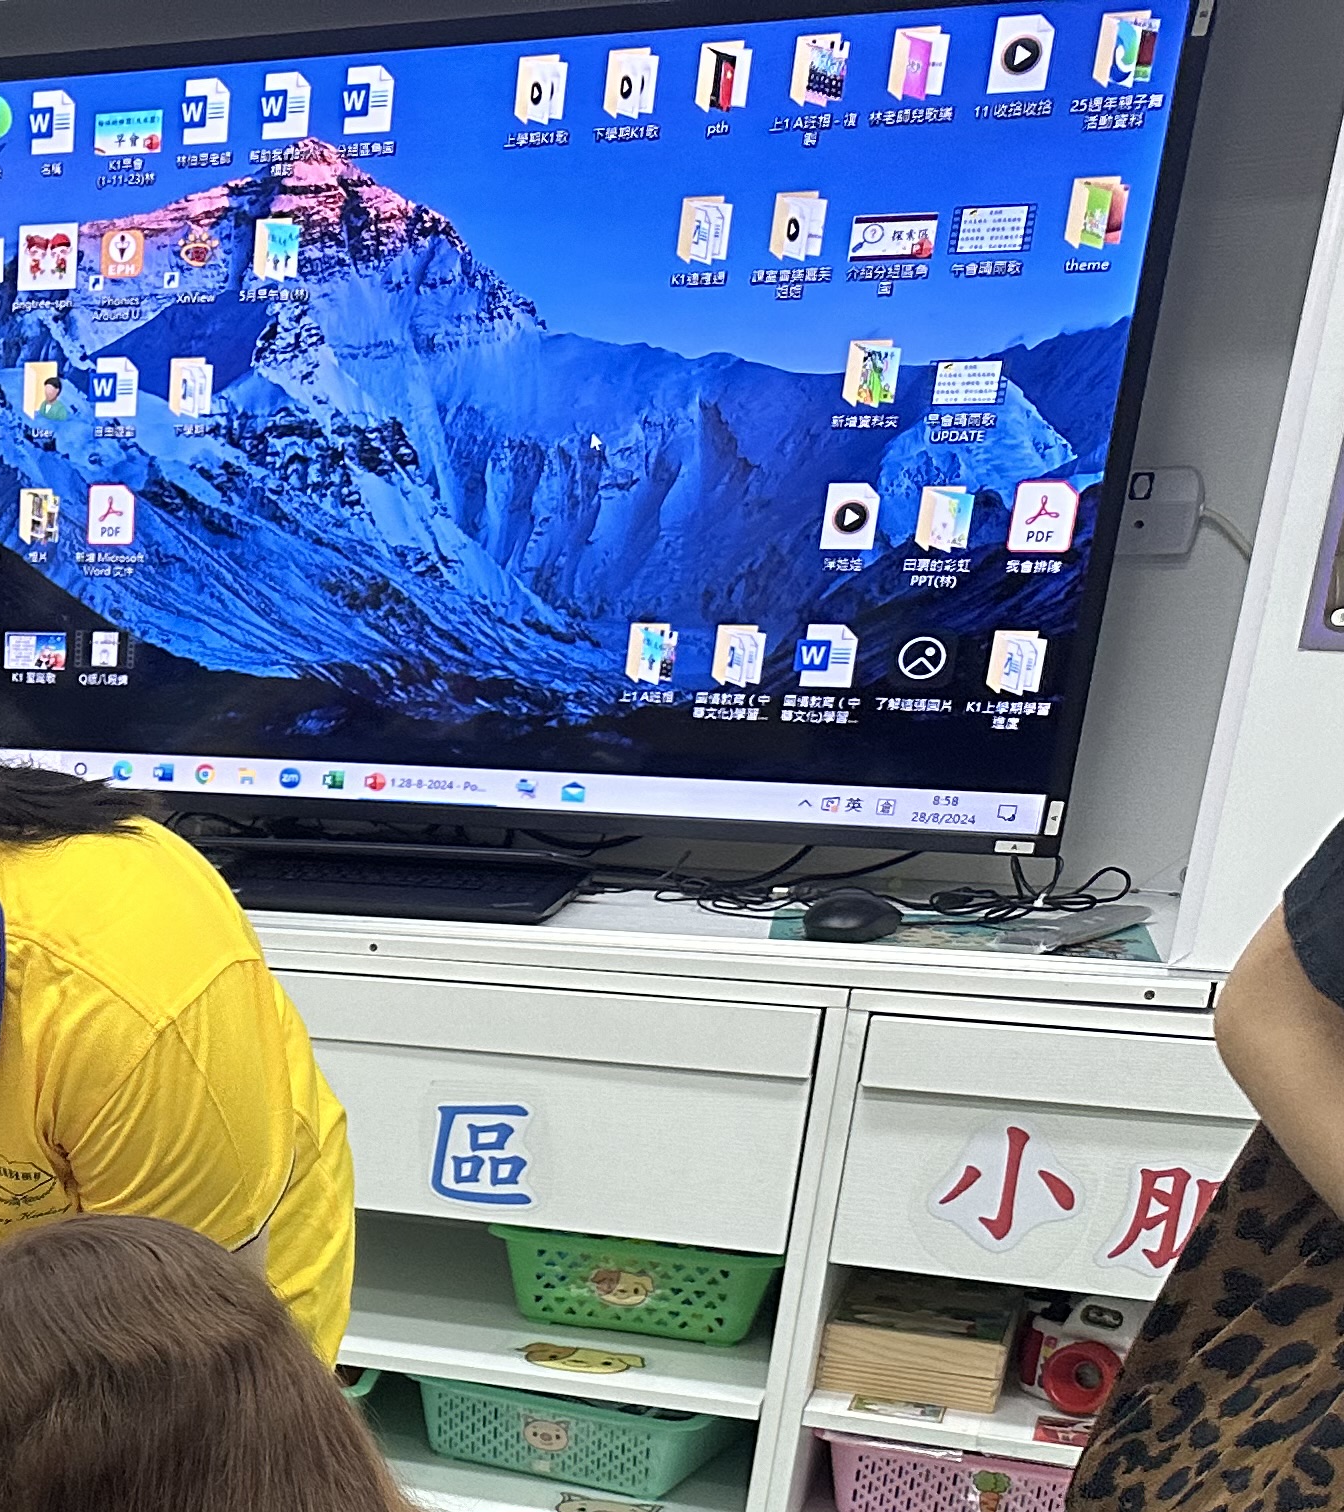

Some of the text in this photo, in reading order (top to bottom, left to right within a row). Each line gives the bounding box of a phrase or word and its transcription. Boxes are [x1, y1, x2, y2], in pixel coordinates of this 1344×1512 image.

[974, 105, 989, 118] 11
[706, 122, 729, 138] pth
[108, 263, 135, 276] EPH
[1064, 258, 1110, 273] theme
[100, 296, 140, 307] Phonics
[176, 292, 216, 305] XnView
[92, 308, 130, 321] Around
[31, 427, 54, 440] User
[930, 430, 985, 443] UPDATE
[100, 525, 121, 539] PDF
[1025, 530, 1055, 544] PDF
[98, 551, 145, 564] Microsoft
[83, 565, 111, 578] Word
[845, 797, 863, 813] 英
[932, 795, 959, 807] 8:58
[911, 811, 976, 826] 28/8/2024
[430, 1104, 532, 1206] 區
